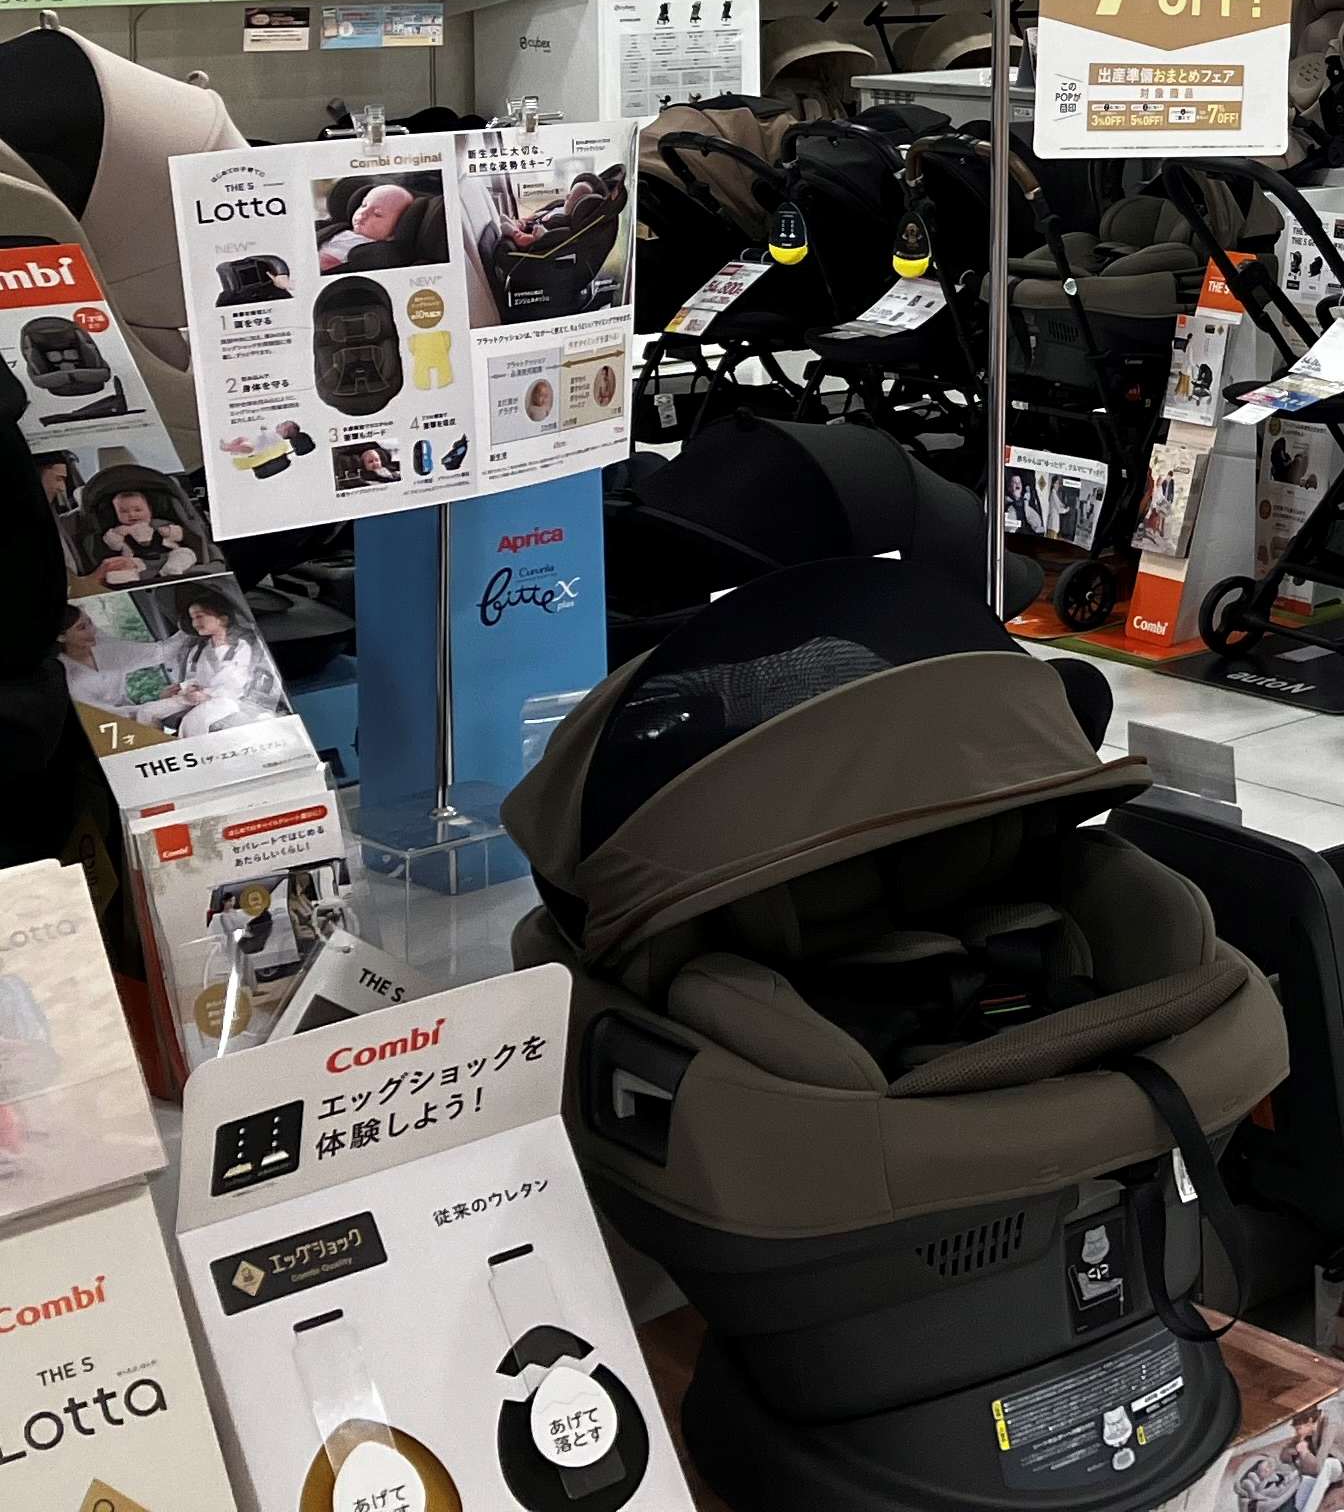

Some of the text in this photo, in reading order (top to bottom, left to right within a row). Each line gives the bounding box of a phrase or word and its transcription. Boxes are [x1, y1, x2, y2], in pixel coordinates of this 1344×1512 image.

[1055, 92, 1082, 102] POPが
[350, 152, 443, 170] Combi Original
[224, 183, 245, 193] THE
[195, 197, 287, 225] Lotta
[1208, 280, 1222, 292] THE
[497, 527, 564, 553] Aprica
[1133, 614, 1168, 637] Combi
[1225, 670, 1318, 696] autoN
[135, 752, 199, 779] THE S
[162, 845, 189, 860] Combi
[359, 968, 392, 996] THE
[326, 1018, 446, 1075] Combi
[317, 1035, 546, 1121] エッグショックを
[315, 1087, 484, 1162] 体験しよう!
[431, 1179, 549, 1227] 従来のウレタン
[267, 1227, 363, 1275] エッグショック
[36, 1355, 95, 1388] THE S
[548, 1407, 599, 1437] あげて
[554, 1426, 602, 1456] 落とす
